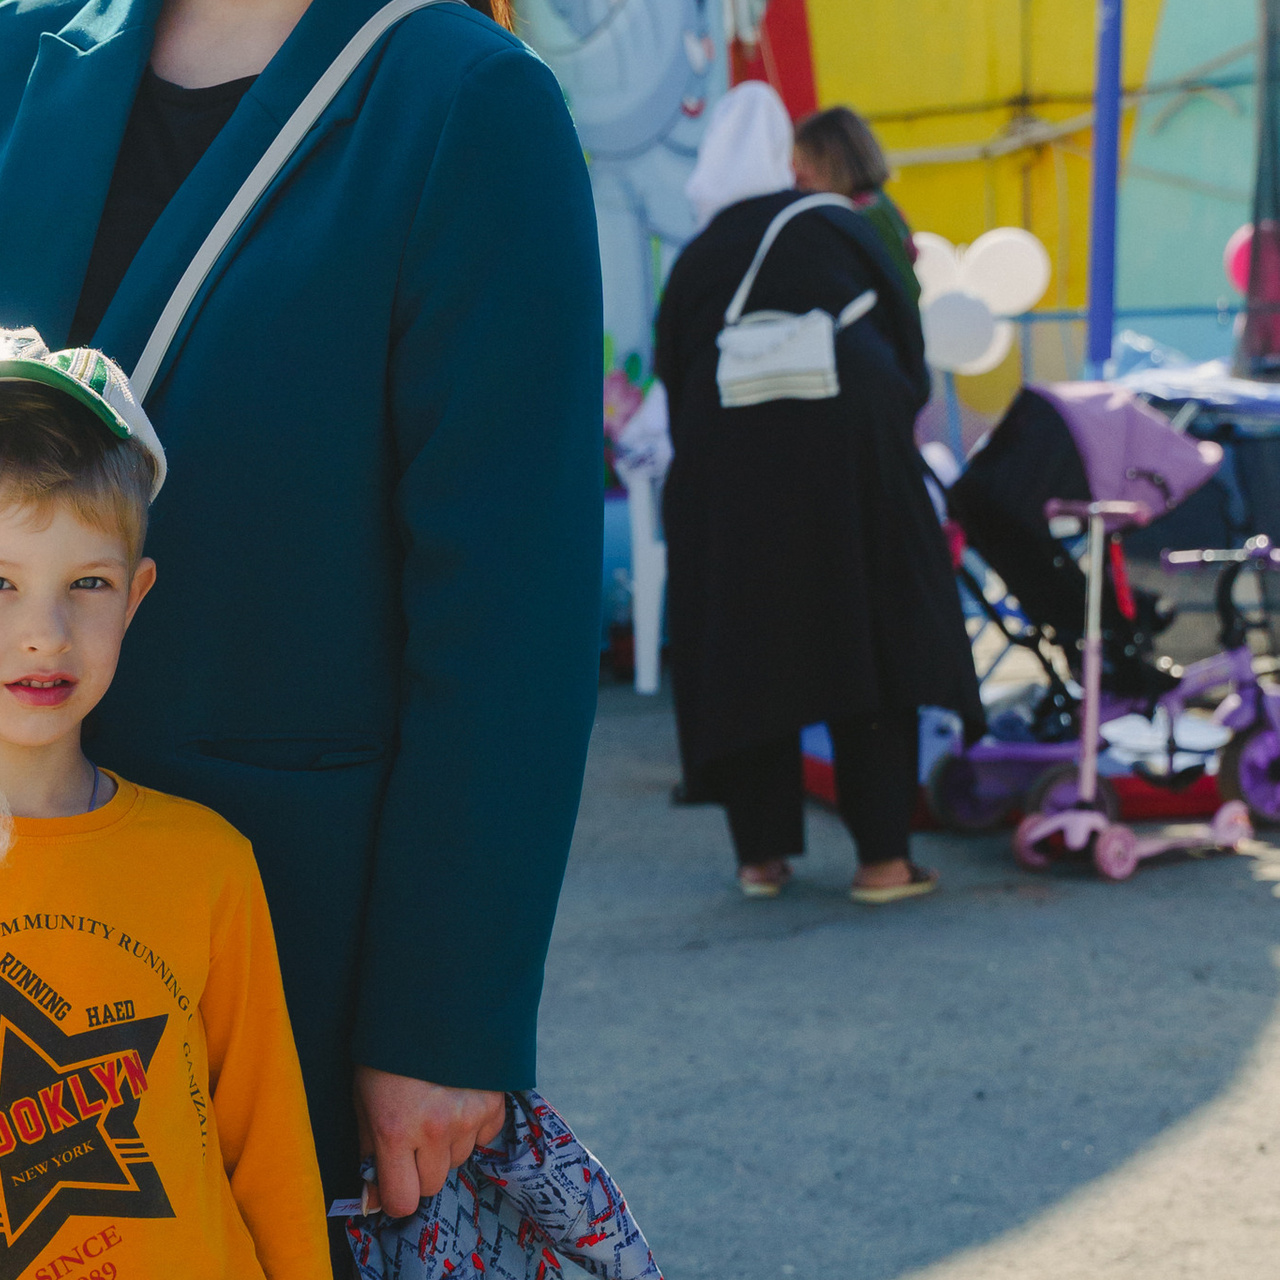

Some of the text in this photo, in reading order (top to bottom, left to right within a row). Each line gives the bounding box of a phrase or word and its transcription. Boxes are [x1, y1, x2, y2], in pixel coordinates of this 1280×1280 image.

[118, 931, 191, 1012] RUNNING
[86, 999, 136, 1028] HAED
[10, 1139, 96, 1187] NEW YORK
